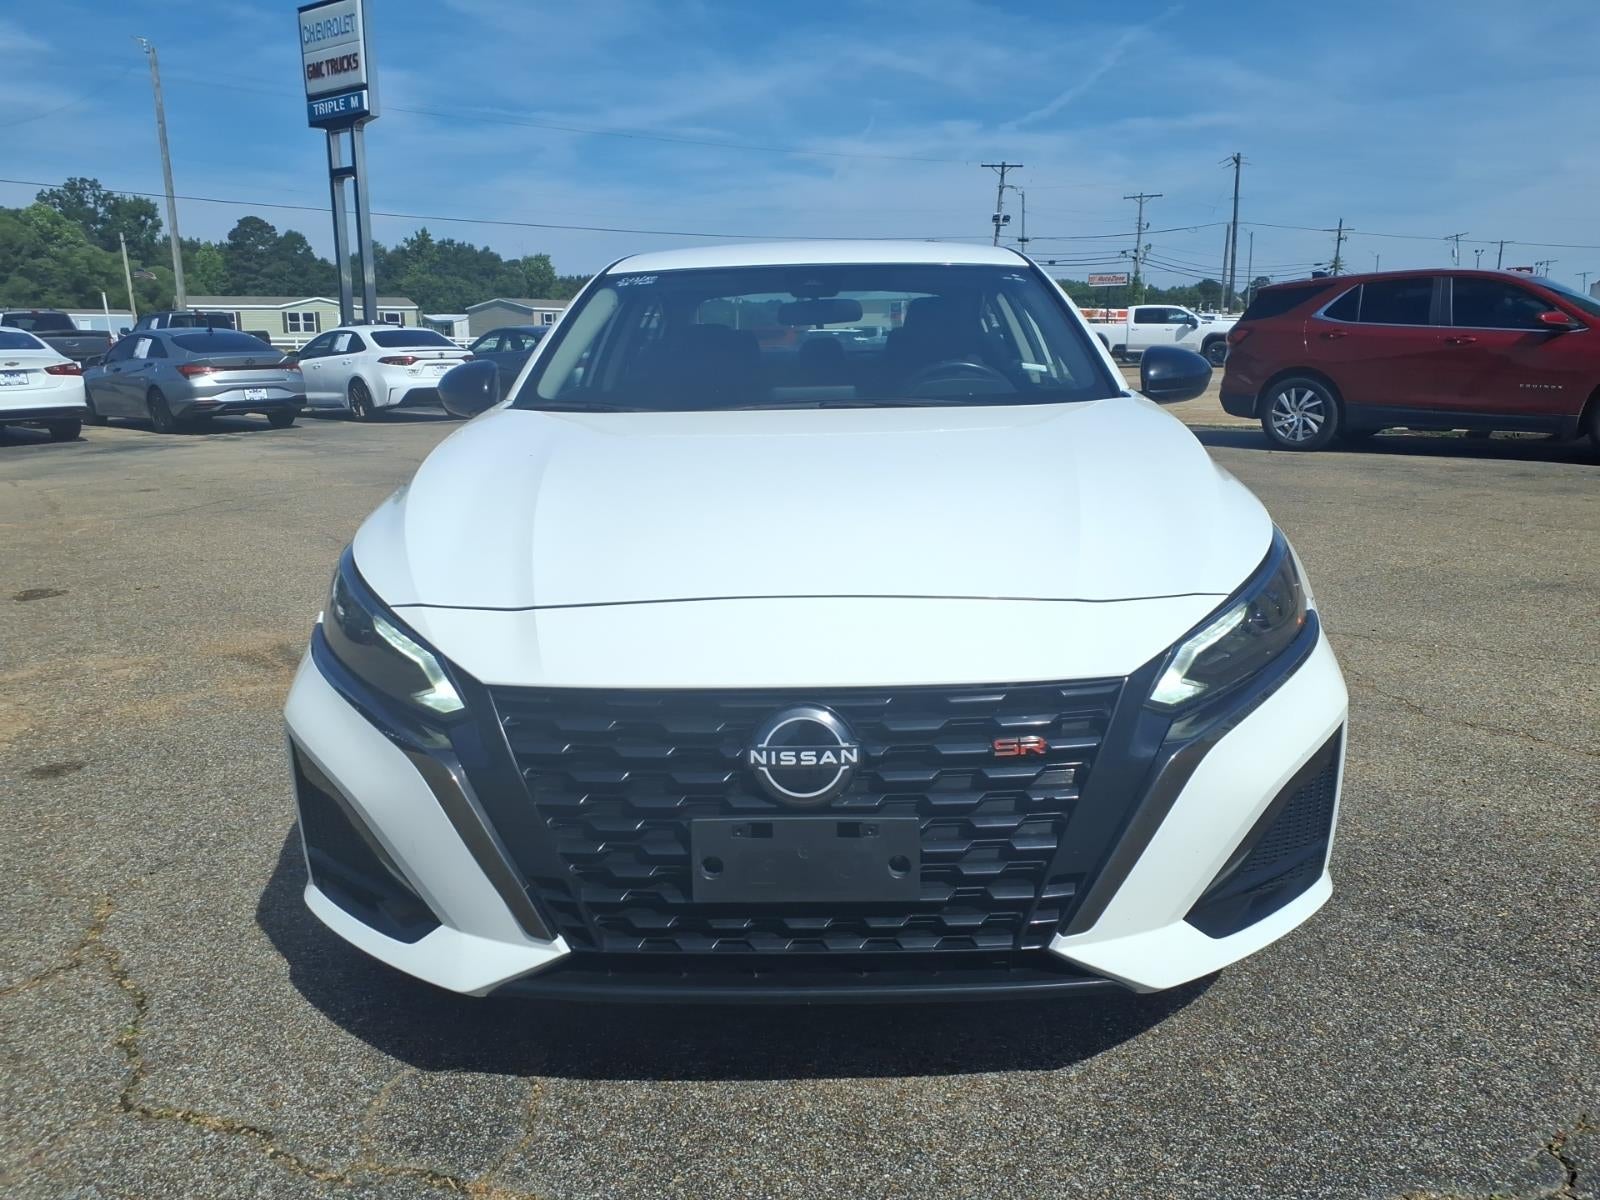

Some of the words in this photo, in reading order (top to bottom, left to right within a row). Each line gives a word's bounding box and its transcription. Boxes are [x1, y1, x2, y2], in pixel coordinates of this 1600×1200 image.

[303, 13, 356, 43] CHEVROLET
[306, 60, 325, 80] GMC
[325, 53, 359, 77] TRUCKS
[313, 99, 346, 115] TRIPLE
[350, 95, 359, 108] M
[993, 736, 1047, 756] SR
[750, 748, 858, 765] NISSAN
